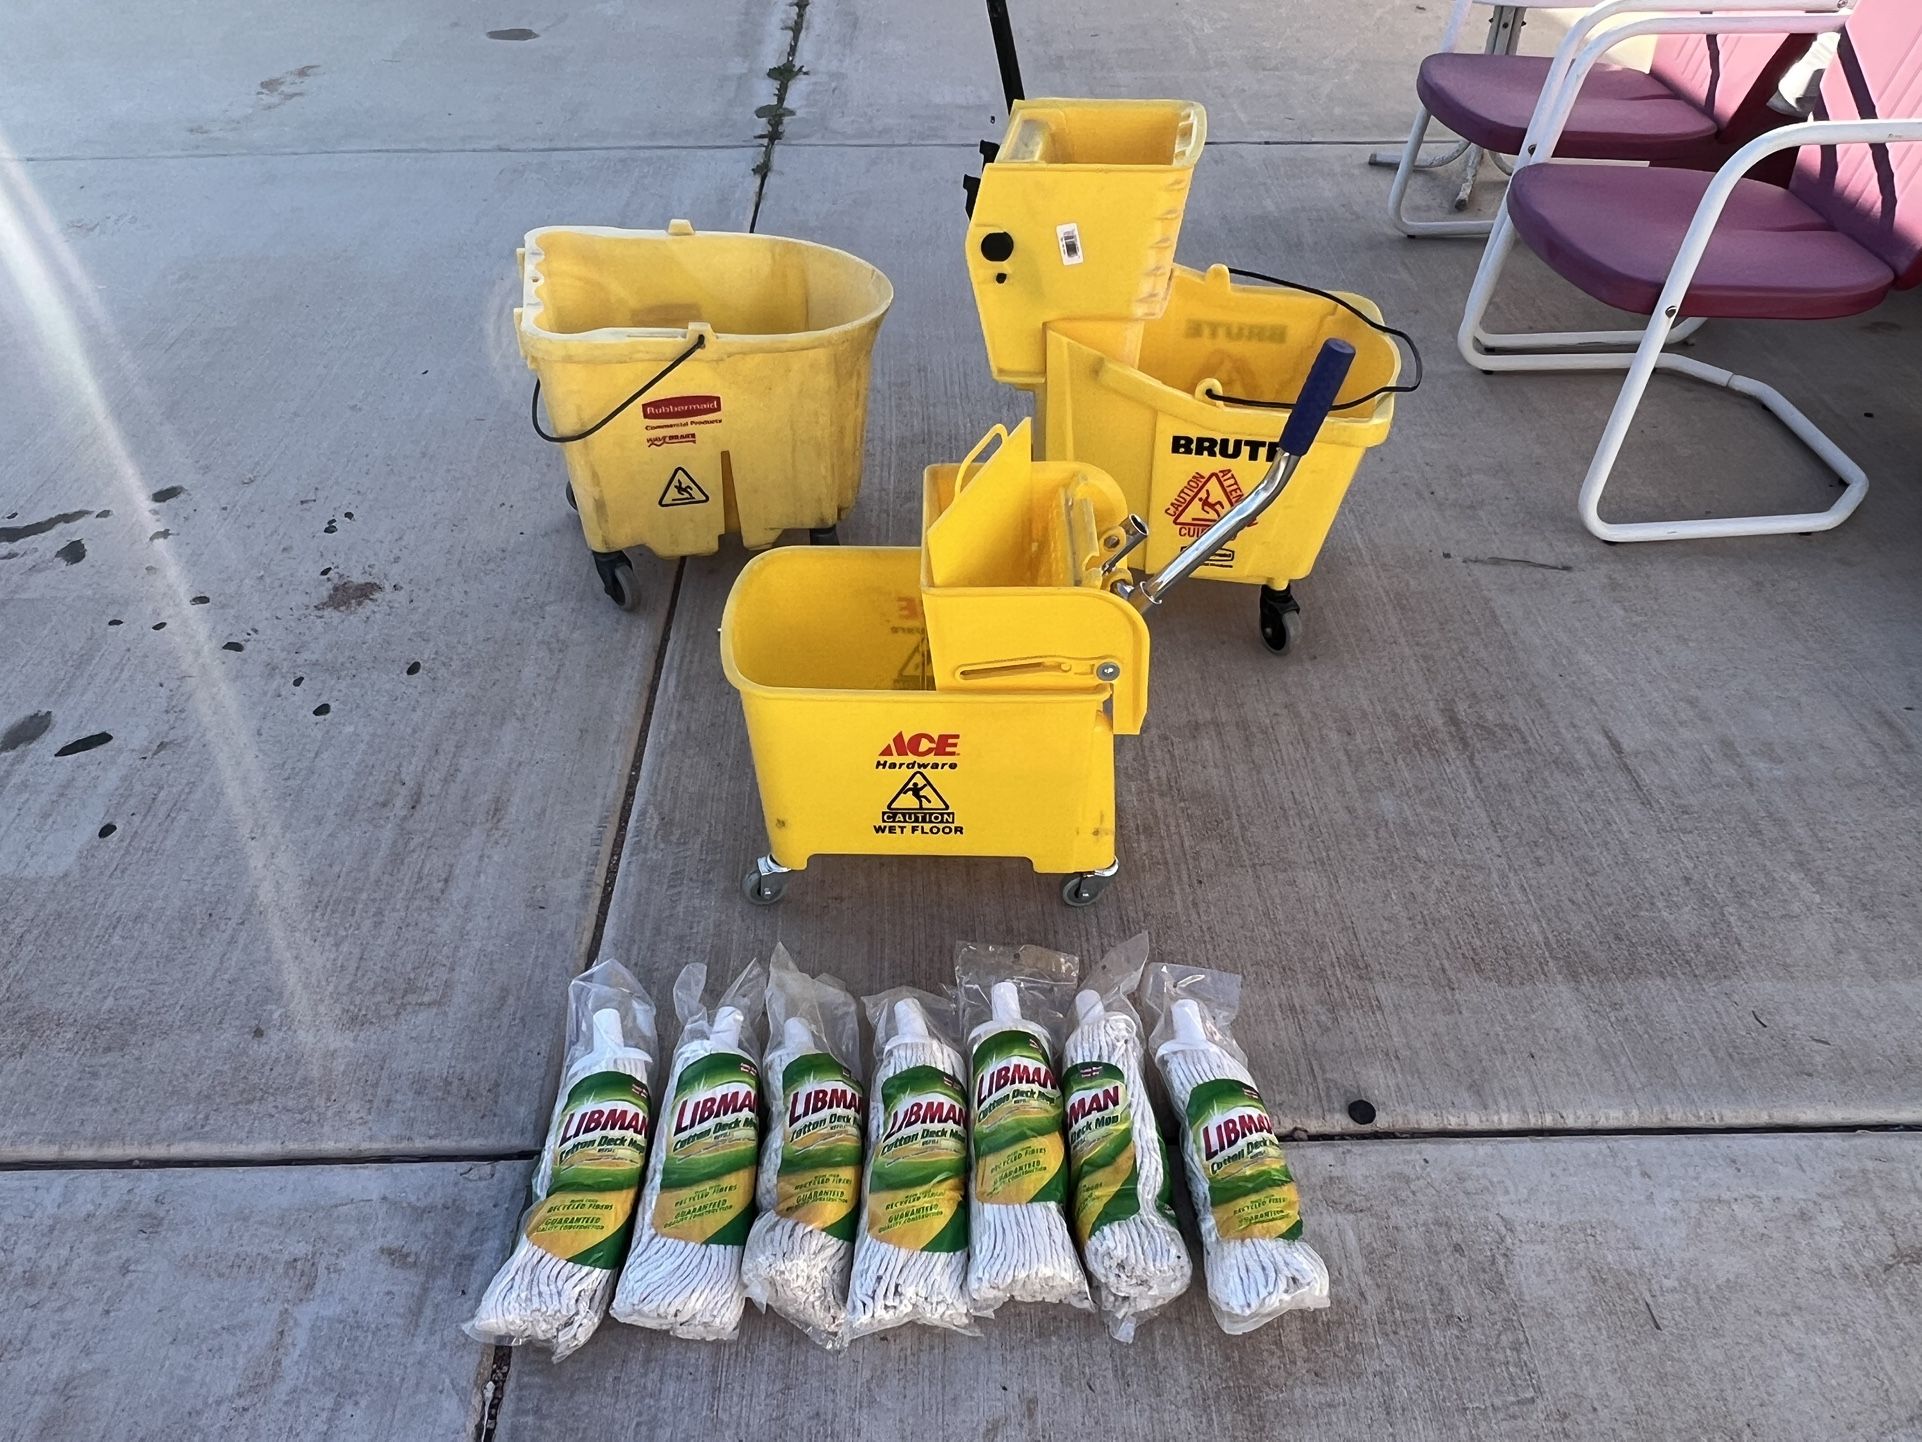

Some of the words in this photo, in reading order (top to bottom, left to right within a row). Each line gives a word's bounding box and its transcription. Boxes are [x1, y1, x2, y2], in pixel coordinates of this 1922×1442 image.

[646, 400, 718, 415] Rubbermaid
[645, 421, 689, 431] Commercial
[690, 419, 723, 427] Products
[1164, 472, 1206, 517] CAUTION
[1219, 468, 1246, 503] ATTEN
[878, 731, 960, 757] ACE
[875, 760, 958, 770] Hardware
[883, 813, 954, 823] CAUTION
[873, 825, 907, 835] WET
[911, 825, 964, 835] FLOOR
[977, 1064, 1058, 1111] LIBMAN
[1012, 1088, 1037, 1099] Deck
[559, 1108, 649, 1148] LIBMAN
[713, 1117, 741, 1135] Deck
[882, 1101, 969, 1144] LIBMAN
[597, 1135, 628, 1147] Deck
[880, 1132, 919, 1156] Cotton
[920, 1128, 948, 1140] Deck
[1210, 1148, 1245, 1175] Cotton
[1246, 1137, 1268, 1156] Deck
